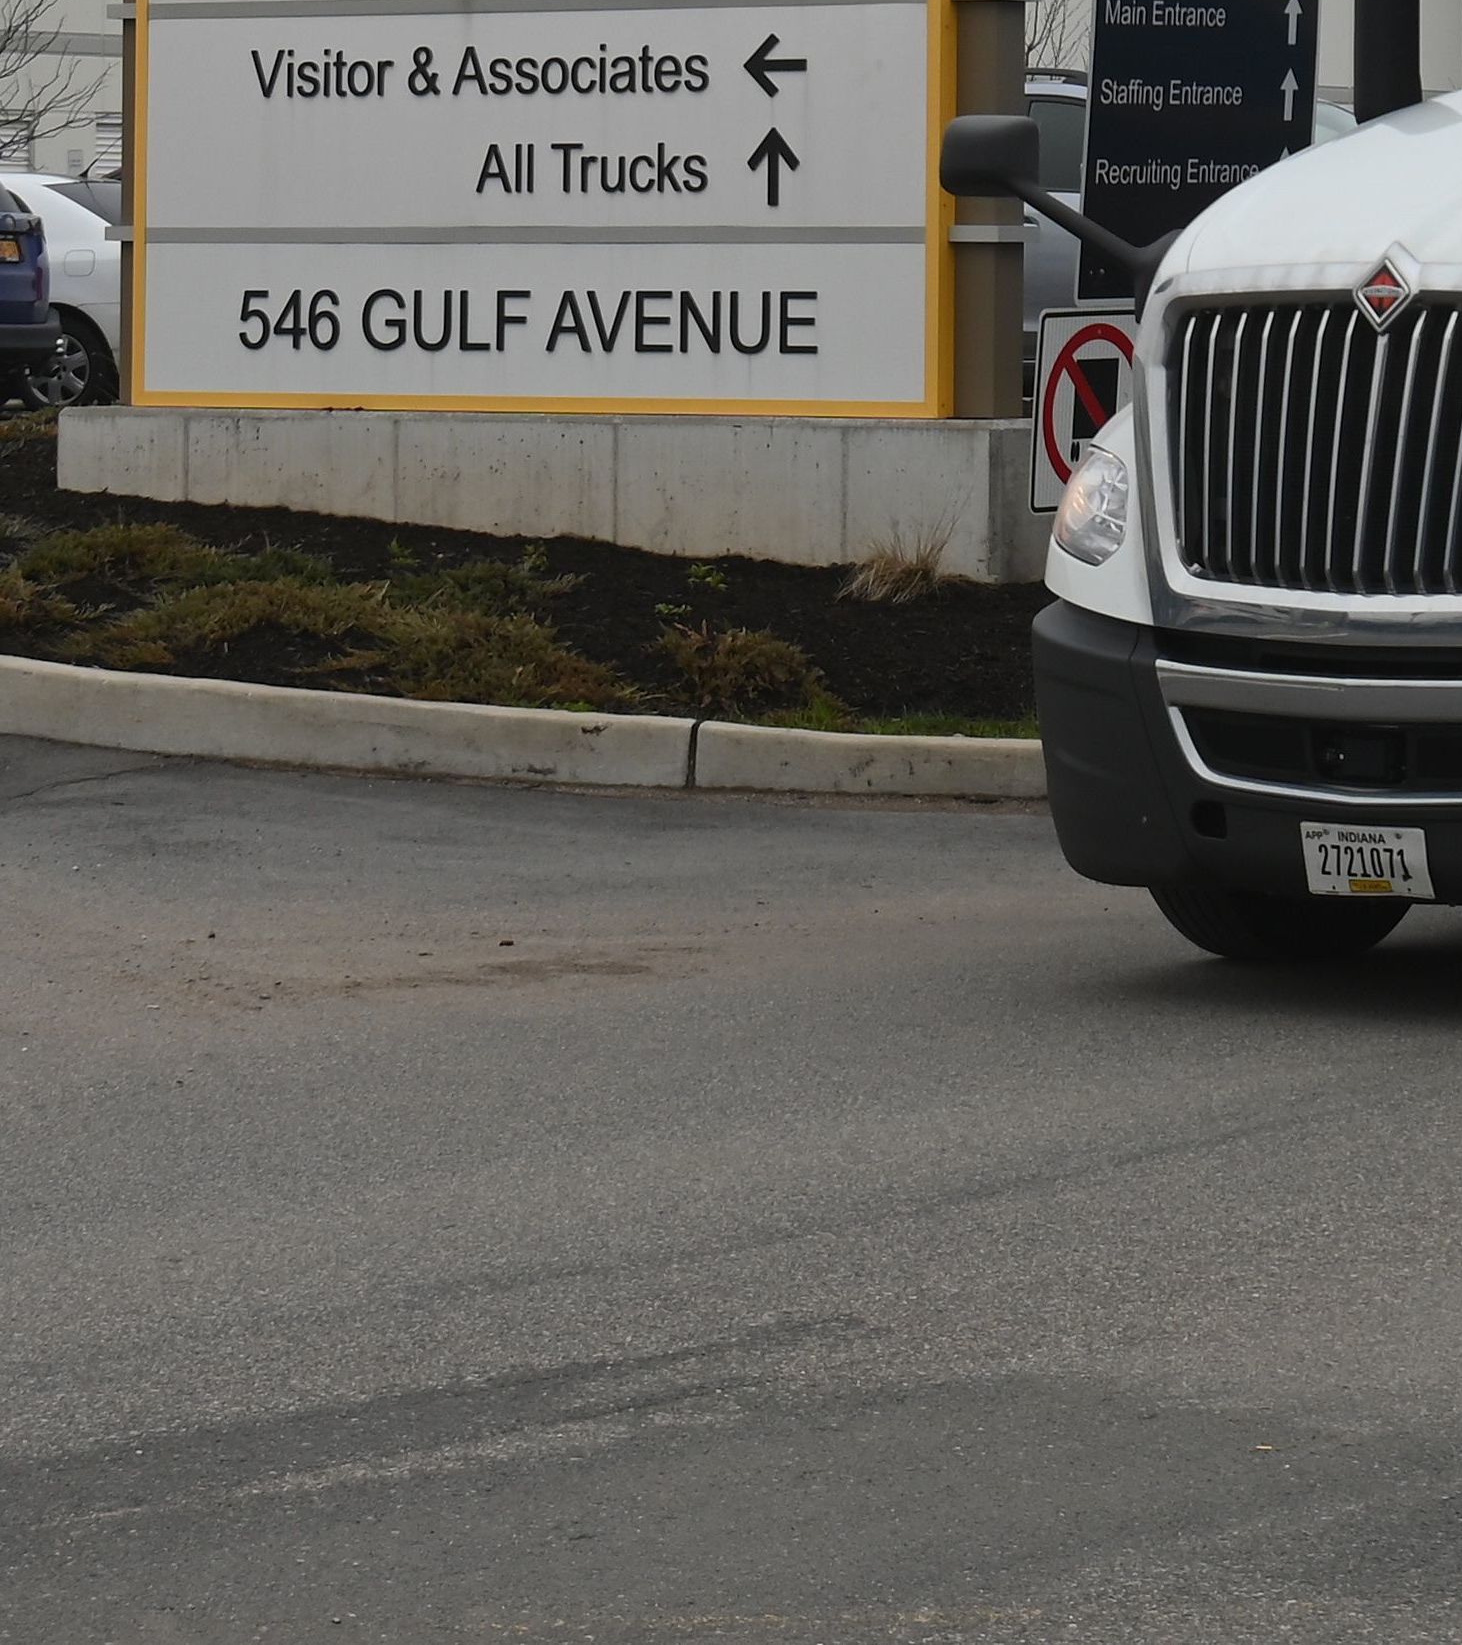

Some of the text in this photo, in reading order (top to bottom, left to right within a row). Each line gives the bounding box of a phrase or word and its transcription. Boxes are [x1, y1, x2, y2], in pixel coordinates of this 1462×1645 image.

[1152, 0, 1226, 27] Entrance
[250, 42, 710, 99] Visitor & Associates
[1100, 78, 1243, 111] Staffing Entrance
[475, 142, 708, 195] All Trucks
[1095, 158, 1181, 191] Recruiting
[238, 288, 818, 355] 546 GULF AVENUE
[1337, 830, 1387, 845] INDIANA
[1318, 843, 1413, 882] 2721071
